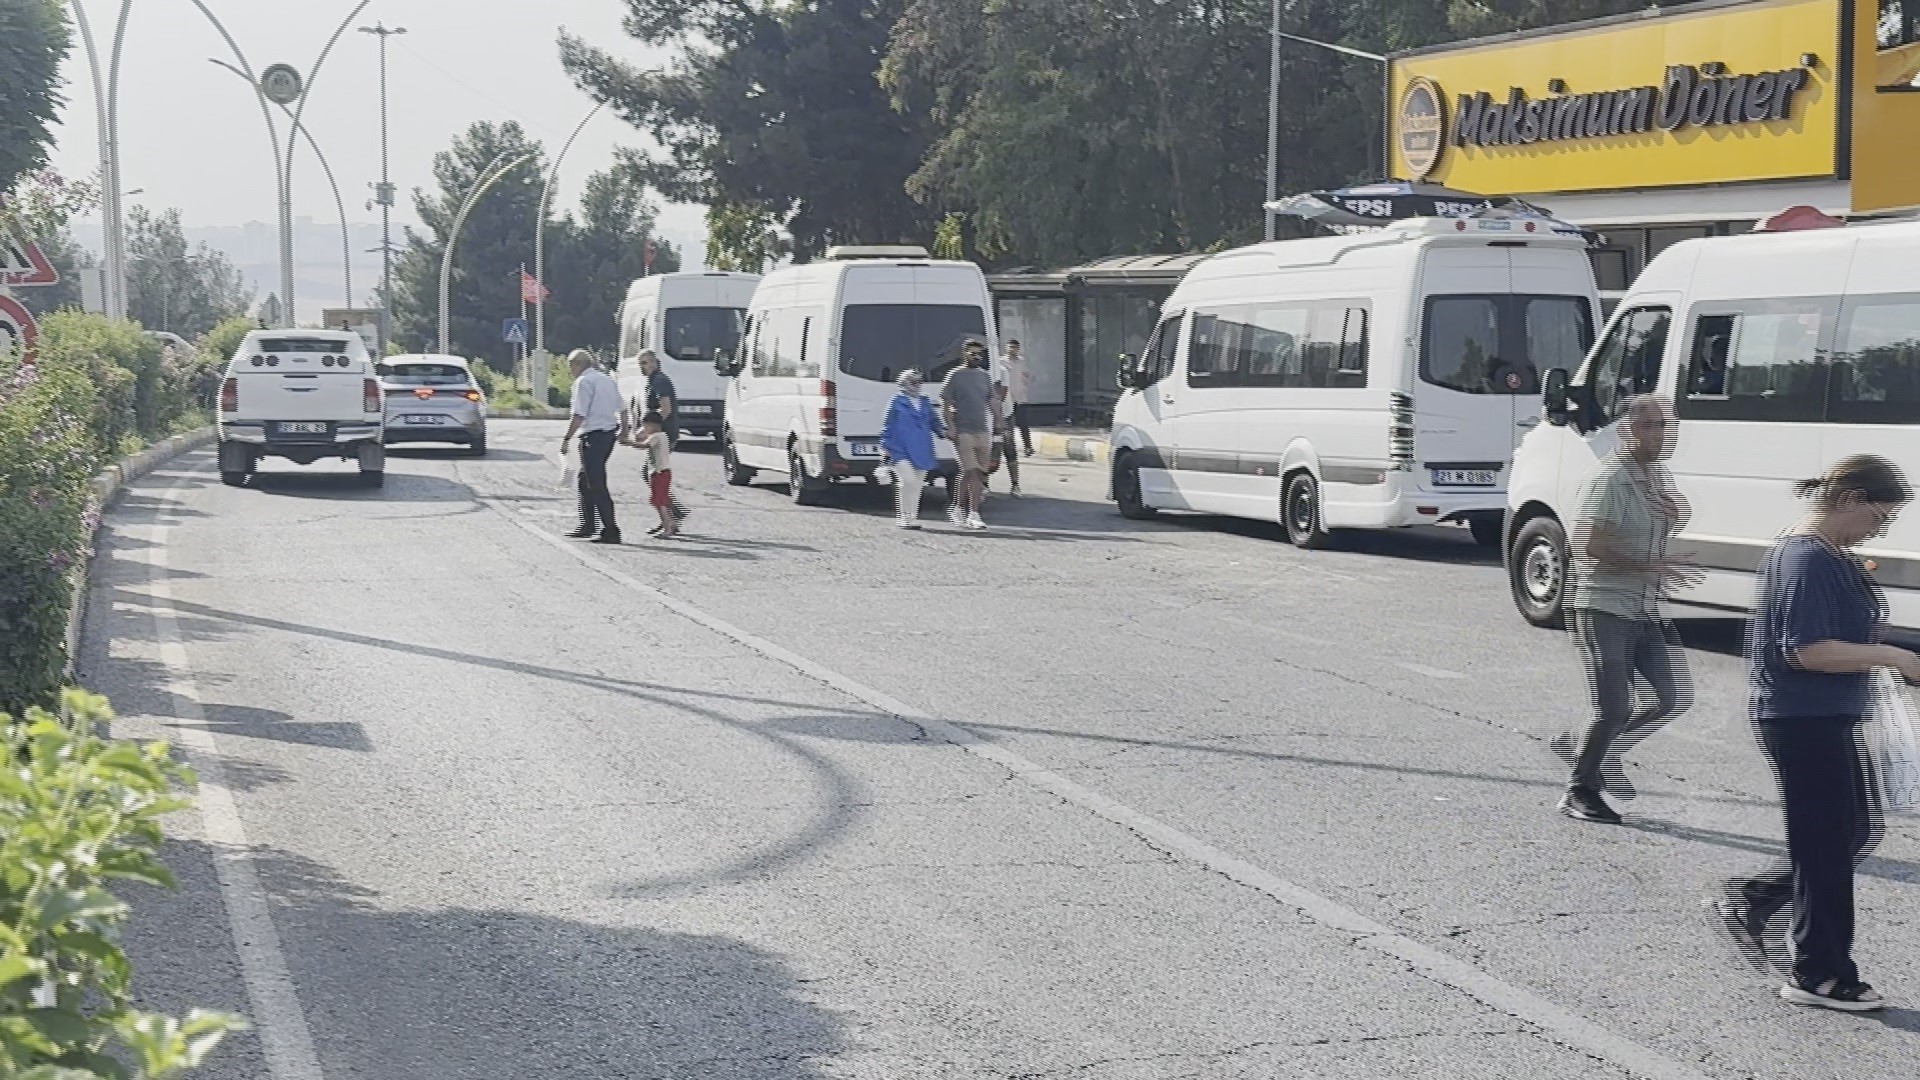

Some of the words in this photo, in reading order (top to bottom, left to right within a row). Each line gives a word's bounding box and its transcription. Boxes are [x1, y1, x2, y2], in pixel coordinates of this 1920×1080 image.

[1452, 78, 1660, 148] Maksimum
[1657, 61, 1810, 131] Döner
[1344, 199, 1393, 217] EPSI
[1439, 471, 1452, 482] 21
